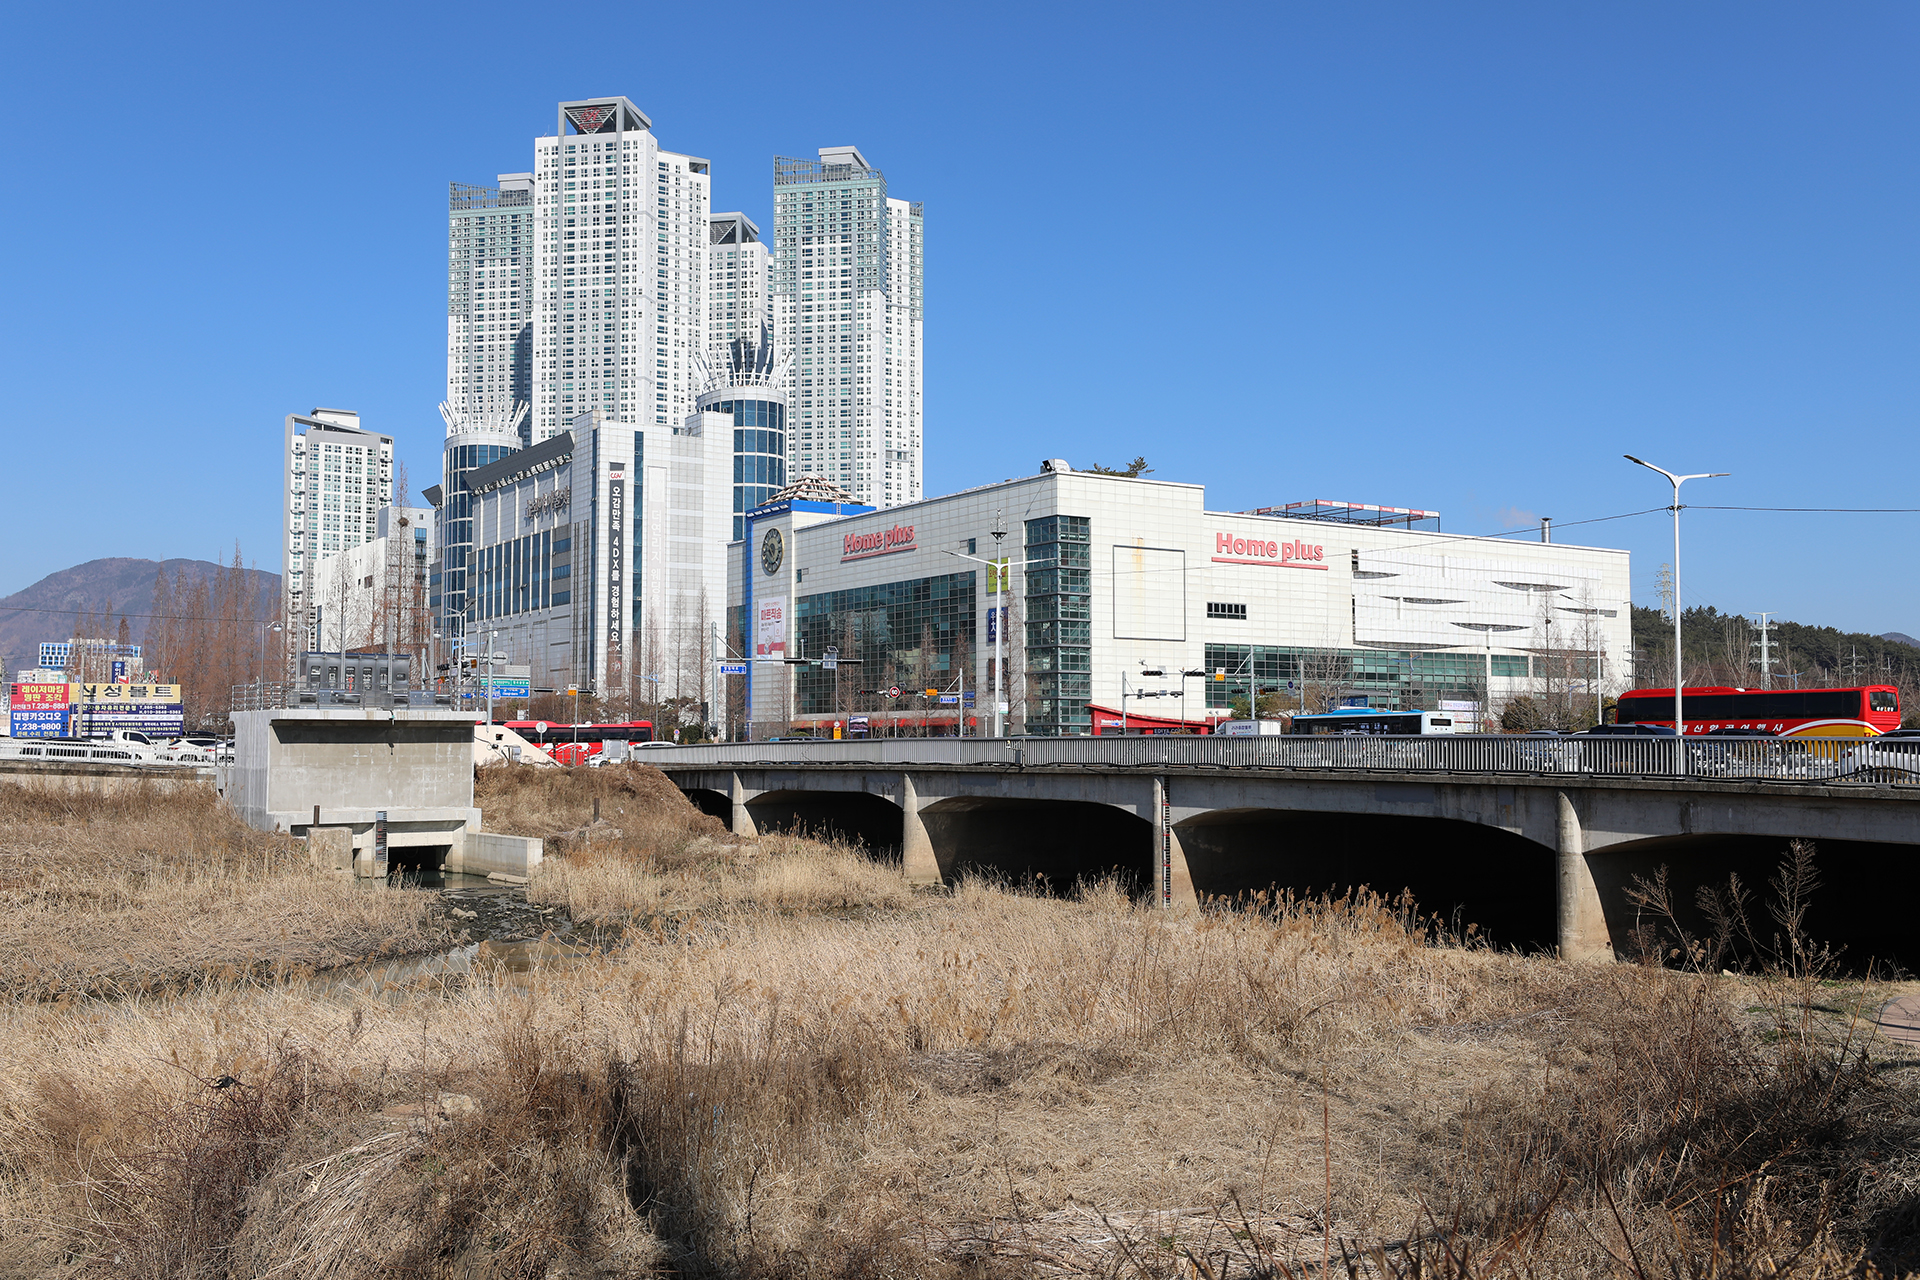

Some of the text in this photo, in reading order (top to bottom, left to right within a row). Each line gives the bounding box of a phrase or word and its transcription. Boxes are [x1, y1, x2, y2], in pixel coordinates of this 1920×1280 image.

[611, 486, 621, 532] 오감만족
[651, 509, 662, 564] 더연리지
[844, 524, 915, 553] Home plus
[1216, 532, 1324, 563] Home plus
[611, 536, 621, 581] 4DX를
[610, 585, 620, 641] 경험하세요
[761, 607, 782, 620] 마트직송
[21, 685, 64, 694] 레이저마킹
[13, 712, 62, 721] 대명카오디오
